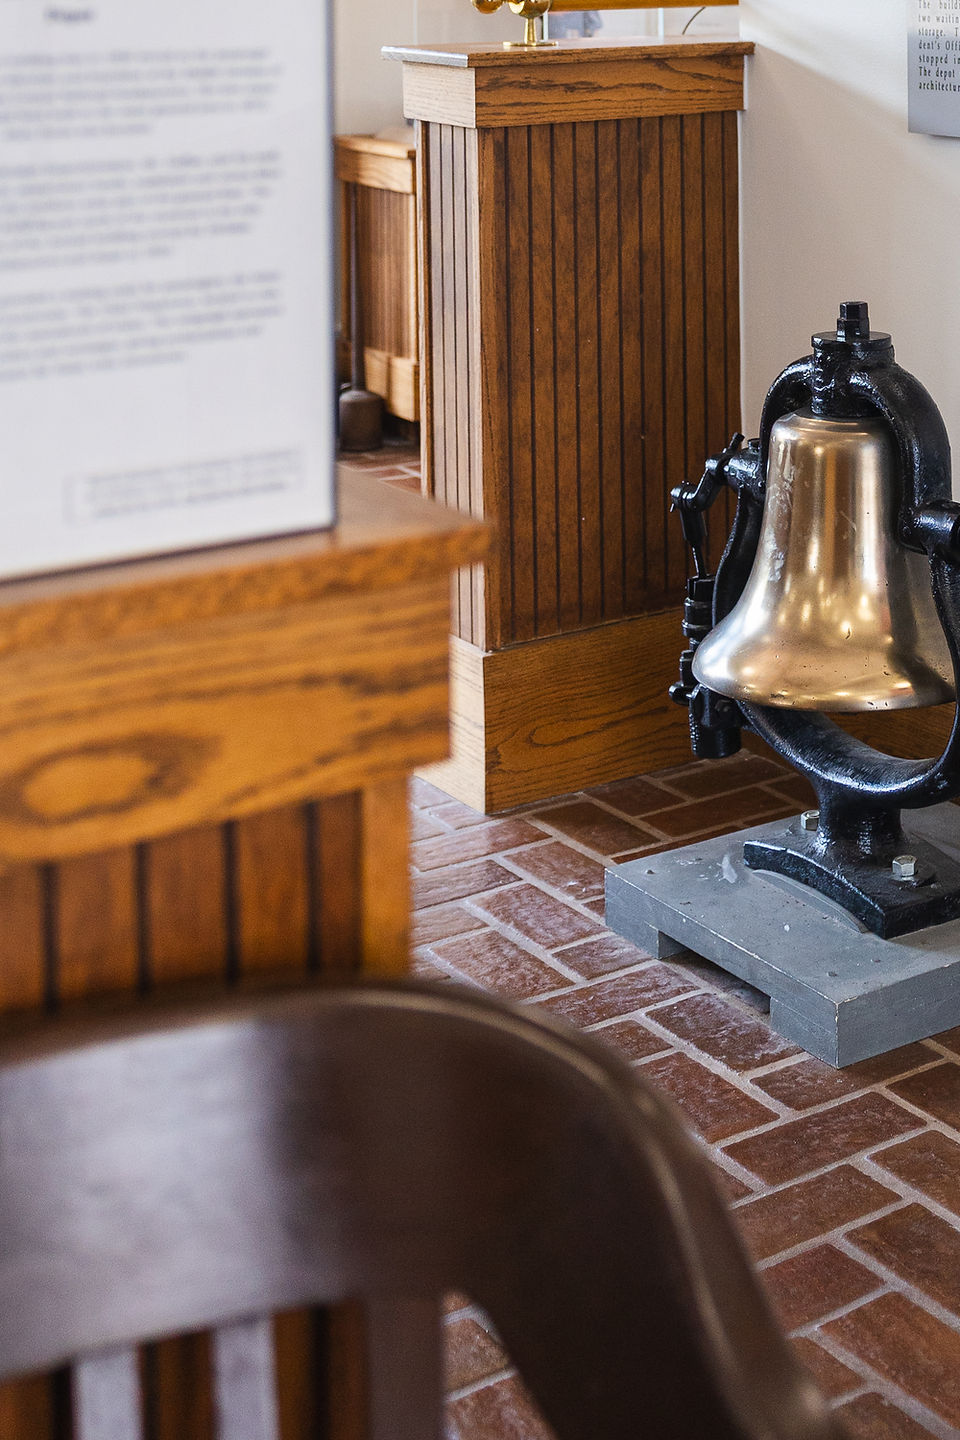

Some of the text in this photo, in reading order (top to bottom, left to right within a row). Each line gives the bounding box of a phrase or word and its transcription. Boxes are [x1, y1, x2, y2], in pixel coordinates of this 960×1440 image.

[918, 13, 930, 22] two
[918, 27, 946, 39] storage.
[919, 40, 940, 50] dent's
[919, 54, 948, 66] stopped
[954, 54, 960, 64] in
[919, 66, 931, 77] The
[936, 67, 955, 80] depot
